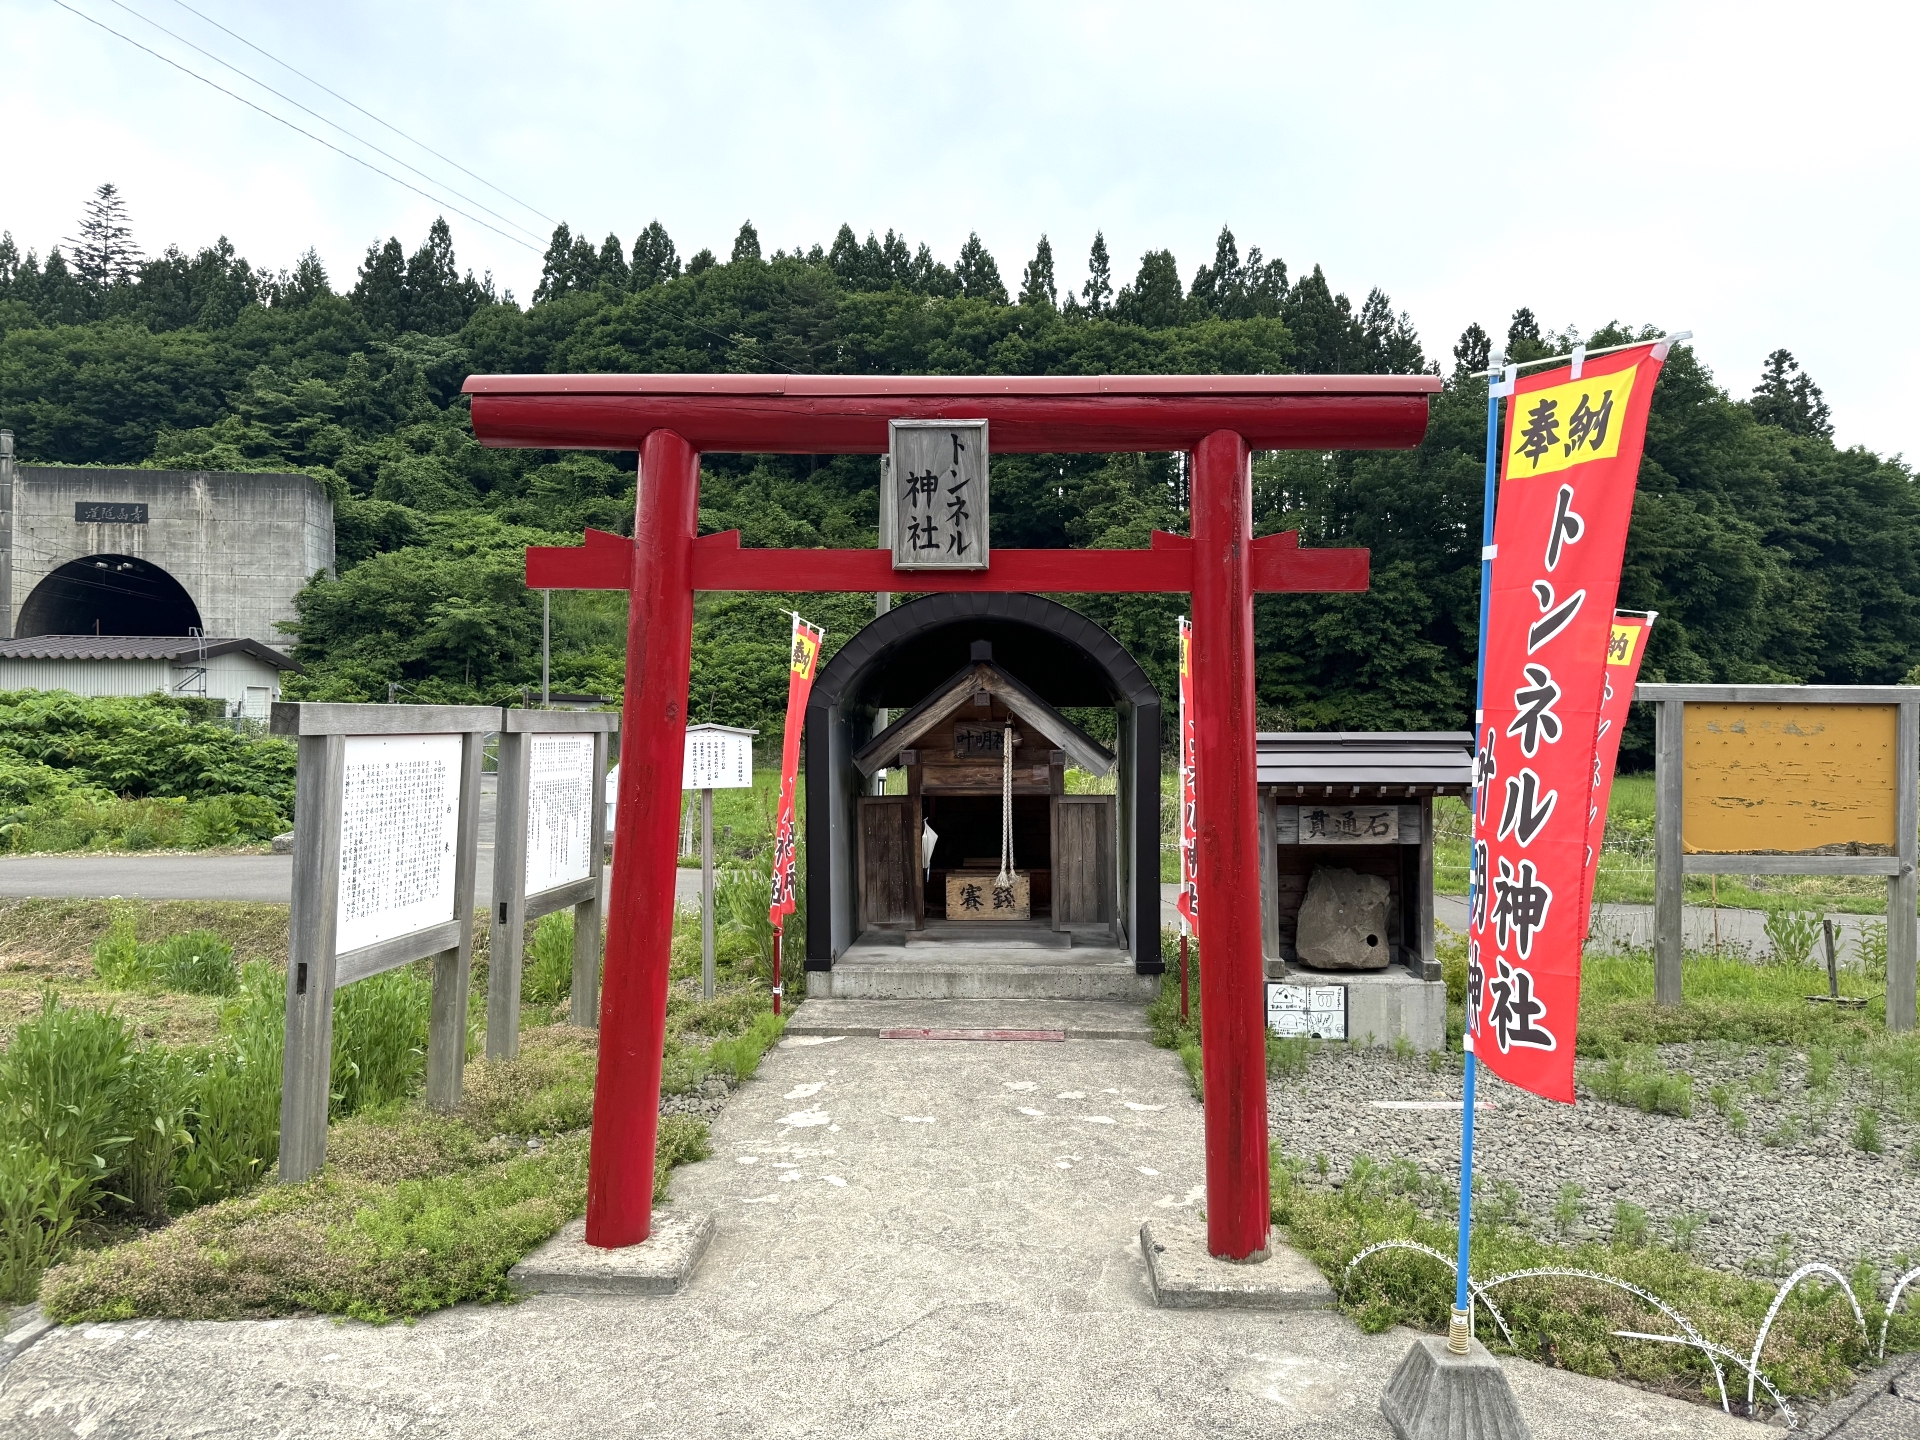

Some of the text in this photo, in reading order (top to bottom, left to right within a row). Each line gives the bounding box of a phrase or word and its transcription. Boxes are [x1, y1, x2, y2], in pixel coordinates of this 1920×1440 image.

[1514, 389, 1614, 469] 奉納
[902, 469, 940, 551] 神社
[945, 433, 972, 556] トンネル
[1490, 484, 1585, 1053] トンネル神社
[1303, 810, 1390, 838] 貫通石
